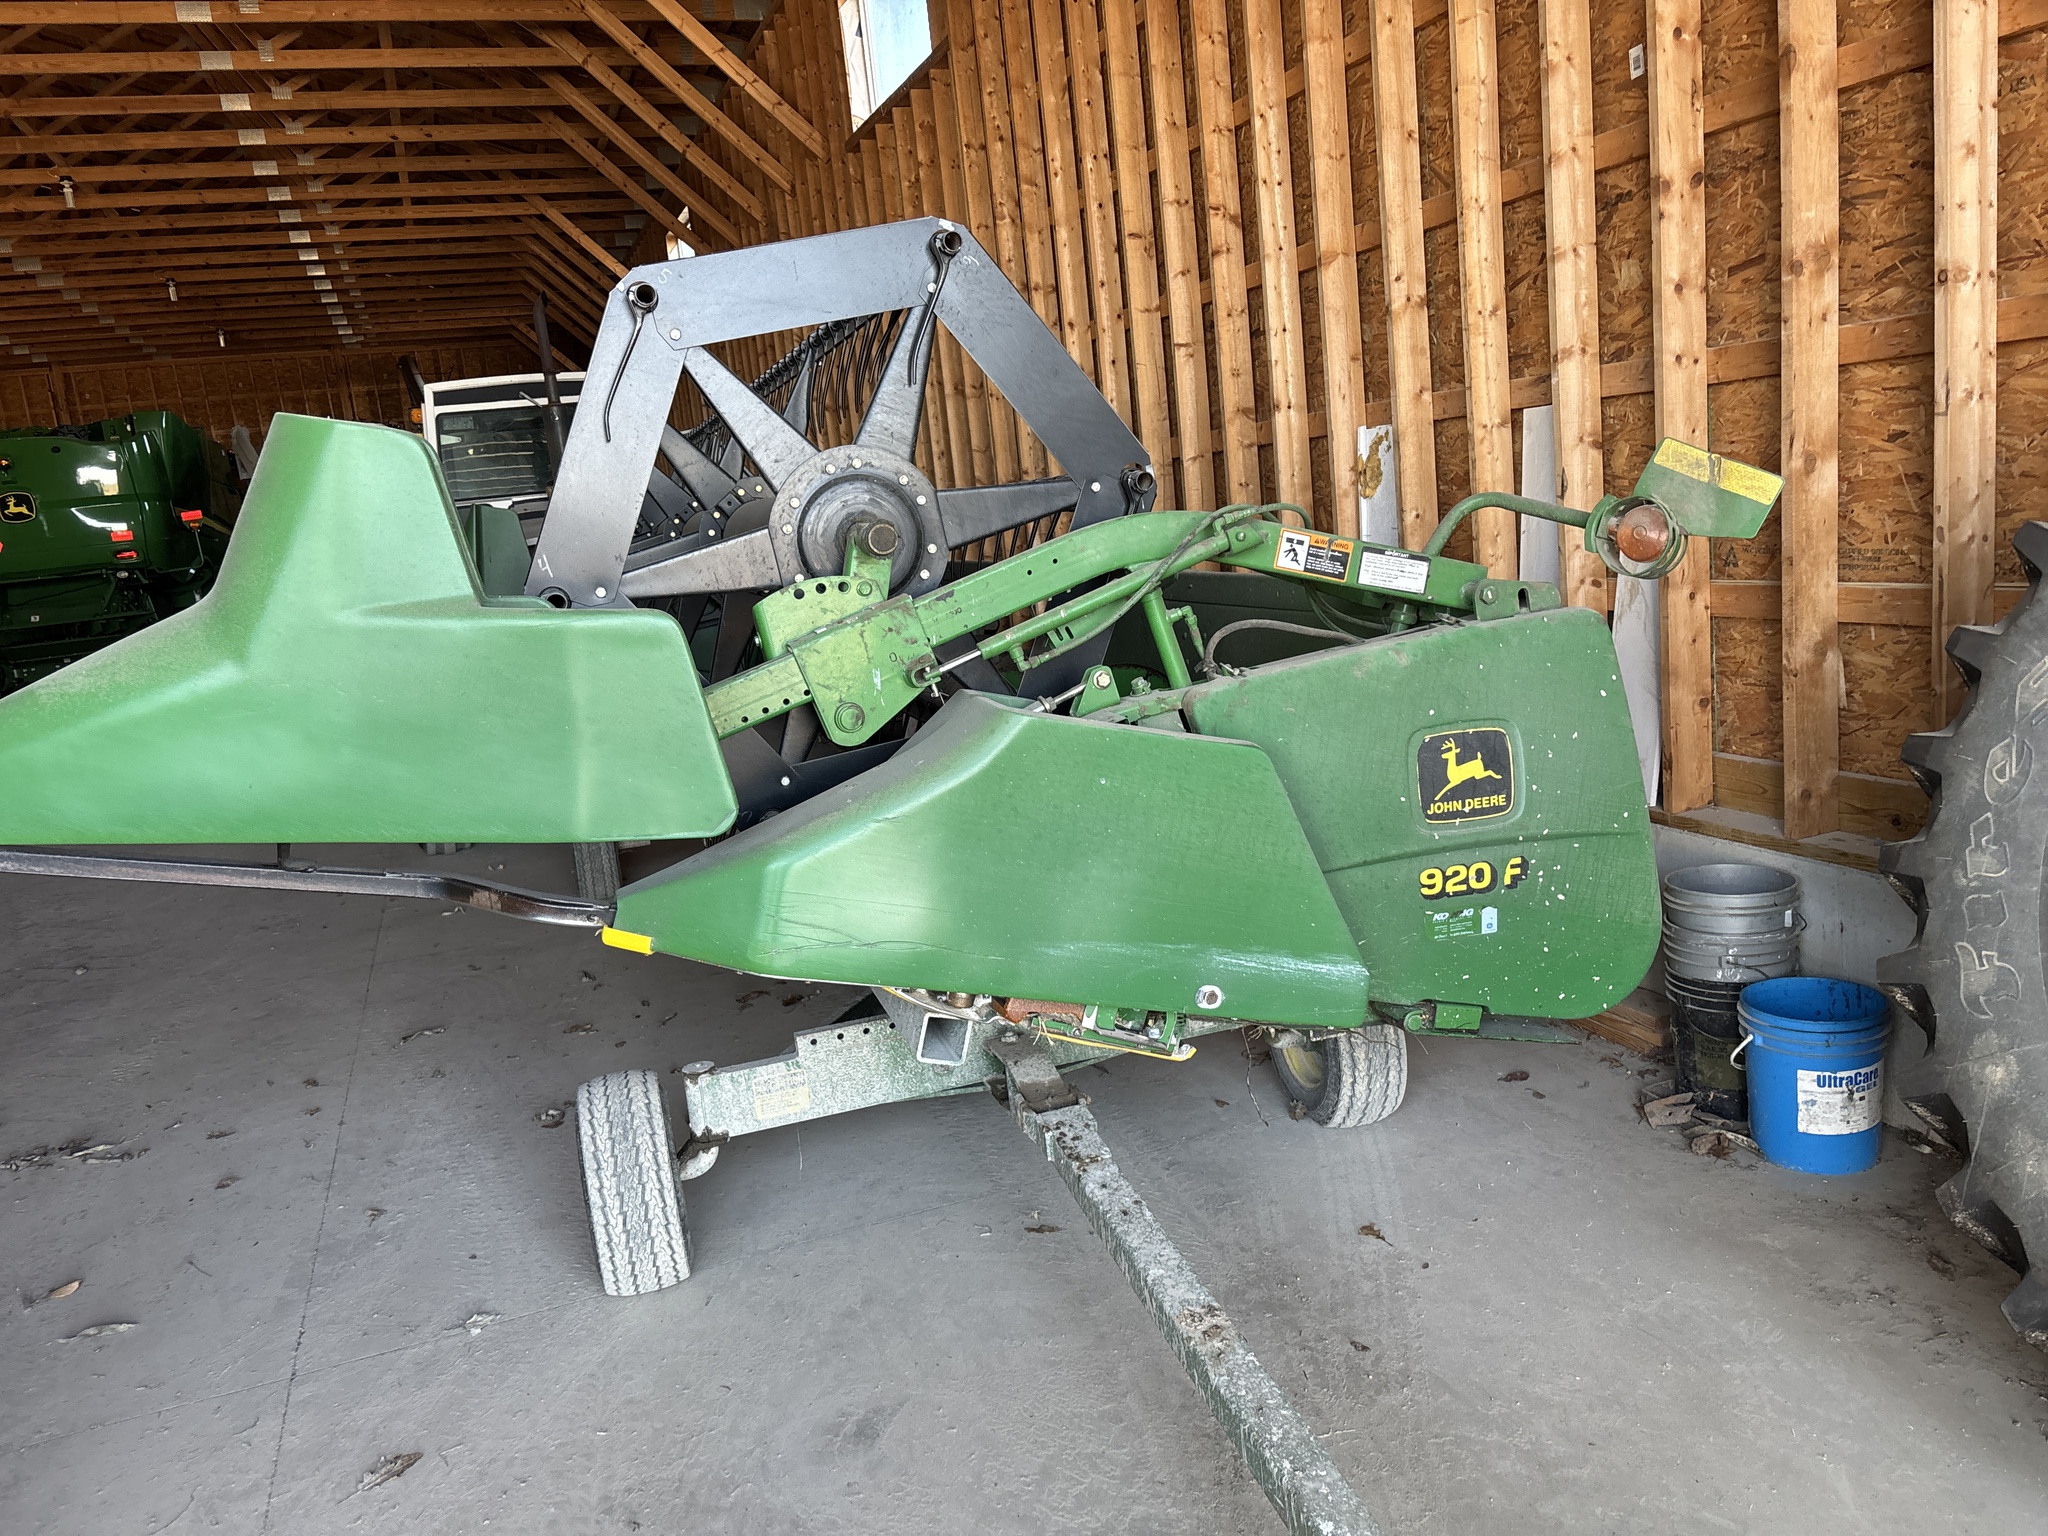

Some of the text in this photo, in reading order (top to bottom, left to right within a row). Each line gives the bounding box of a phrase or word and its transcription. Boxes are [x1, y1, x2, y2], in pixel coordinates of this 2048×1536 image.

[1319, 538, 1349, 550] WANING
[1384, 550, 1409, 558] IMPORTANT
[537, 554, 553, 578] 4
[1427, 794, 1507, 815] JOHN DEERE
[1419, 856, 1527, 899] 920 F
[1816, 1066, 1879, 1088] UltraCare
